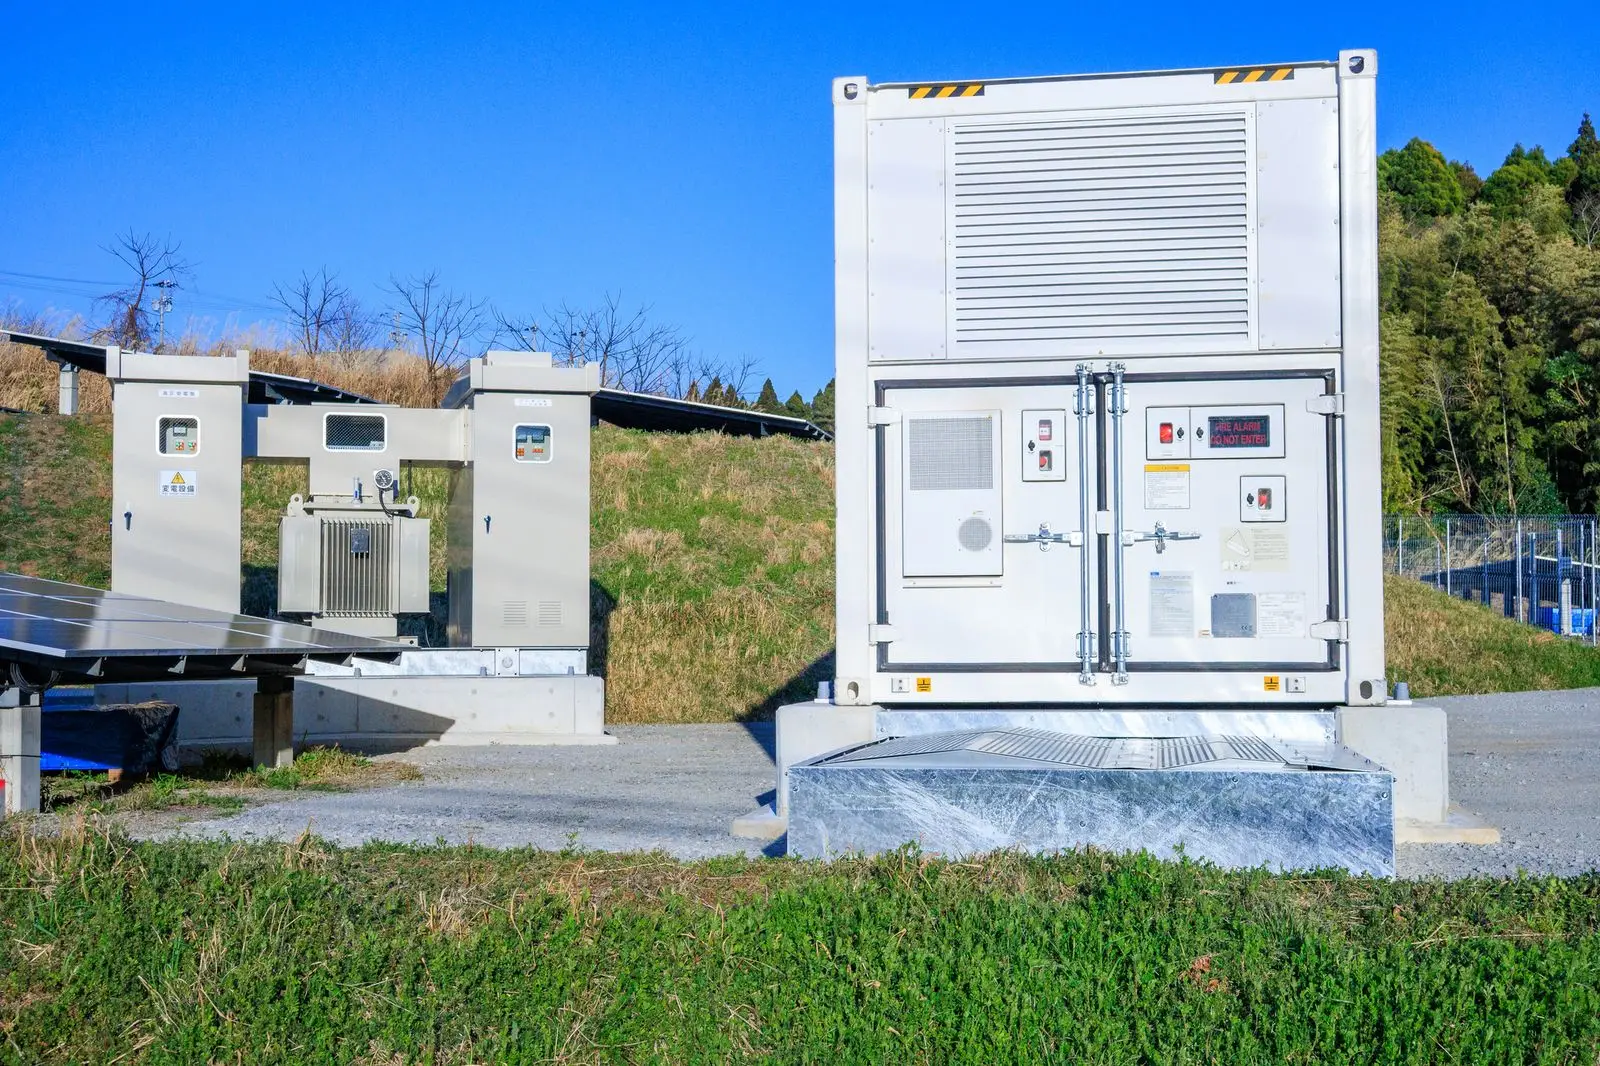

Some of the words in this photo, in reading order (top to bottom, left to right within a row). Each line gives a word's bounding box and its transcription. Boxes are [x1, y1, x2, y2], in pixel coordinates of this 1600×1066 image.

[1215, 422, 1231, 431] FIRE
[1233, 421, 1261, 431] ALARM
[1223, 435, 1239, 444] NOT
[1241, 434, 1266, 444] ENTER
